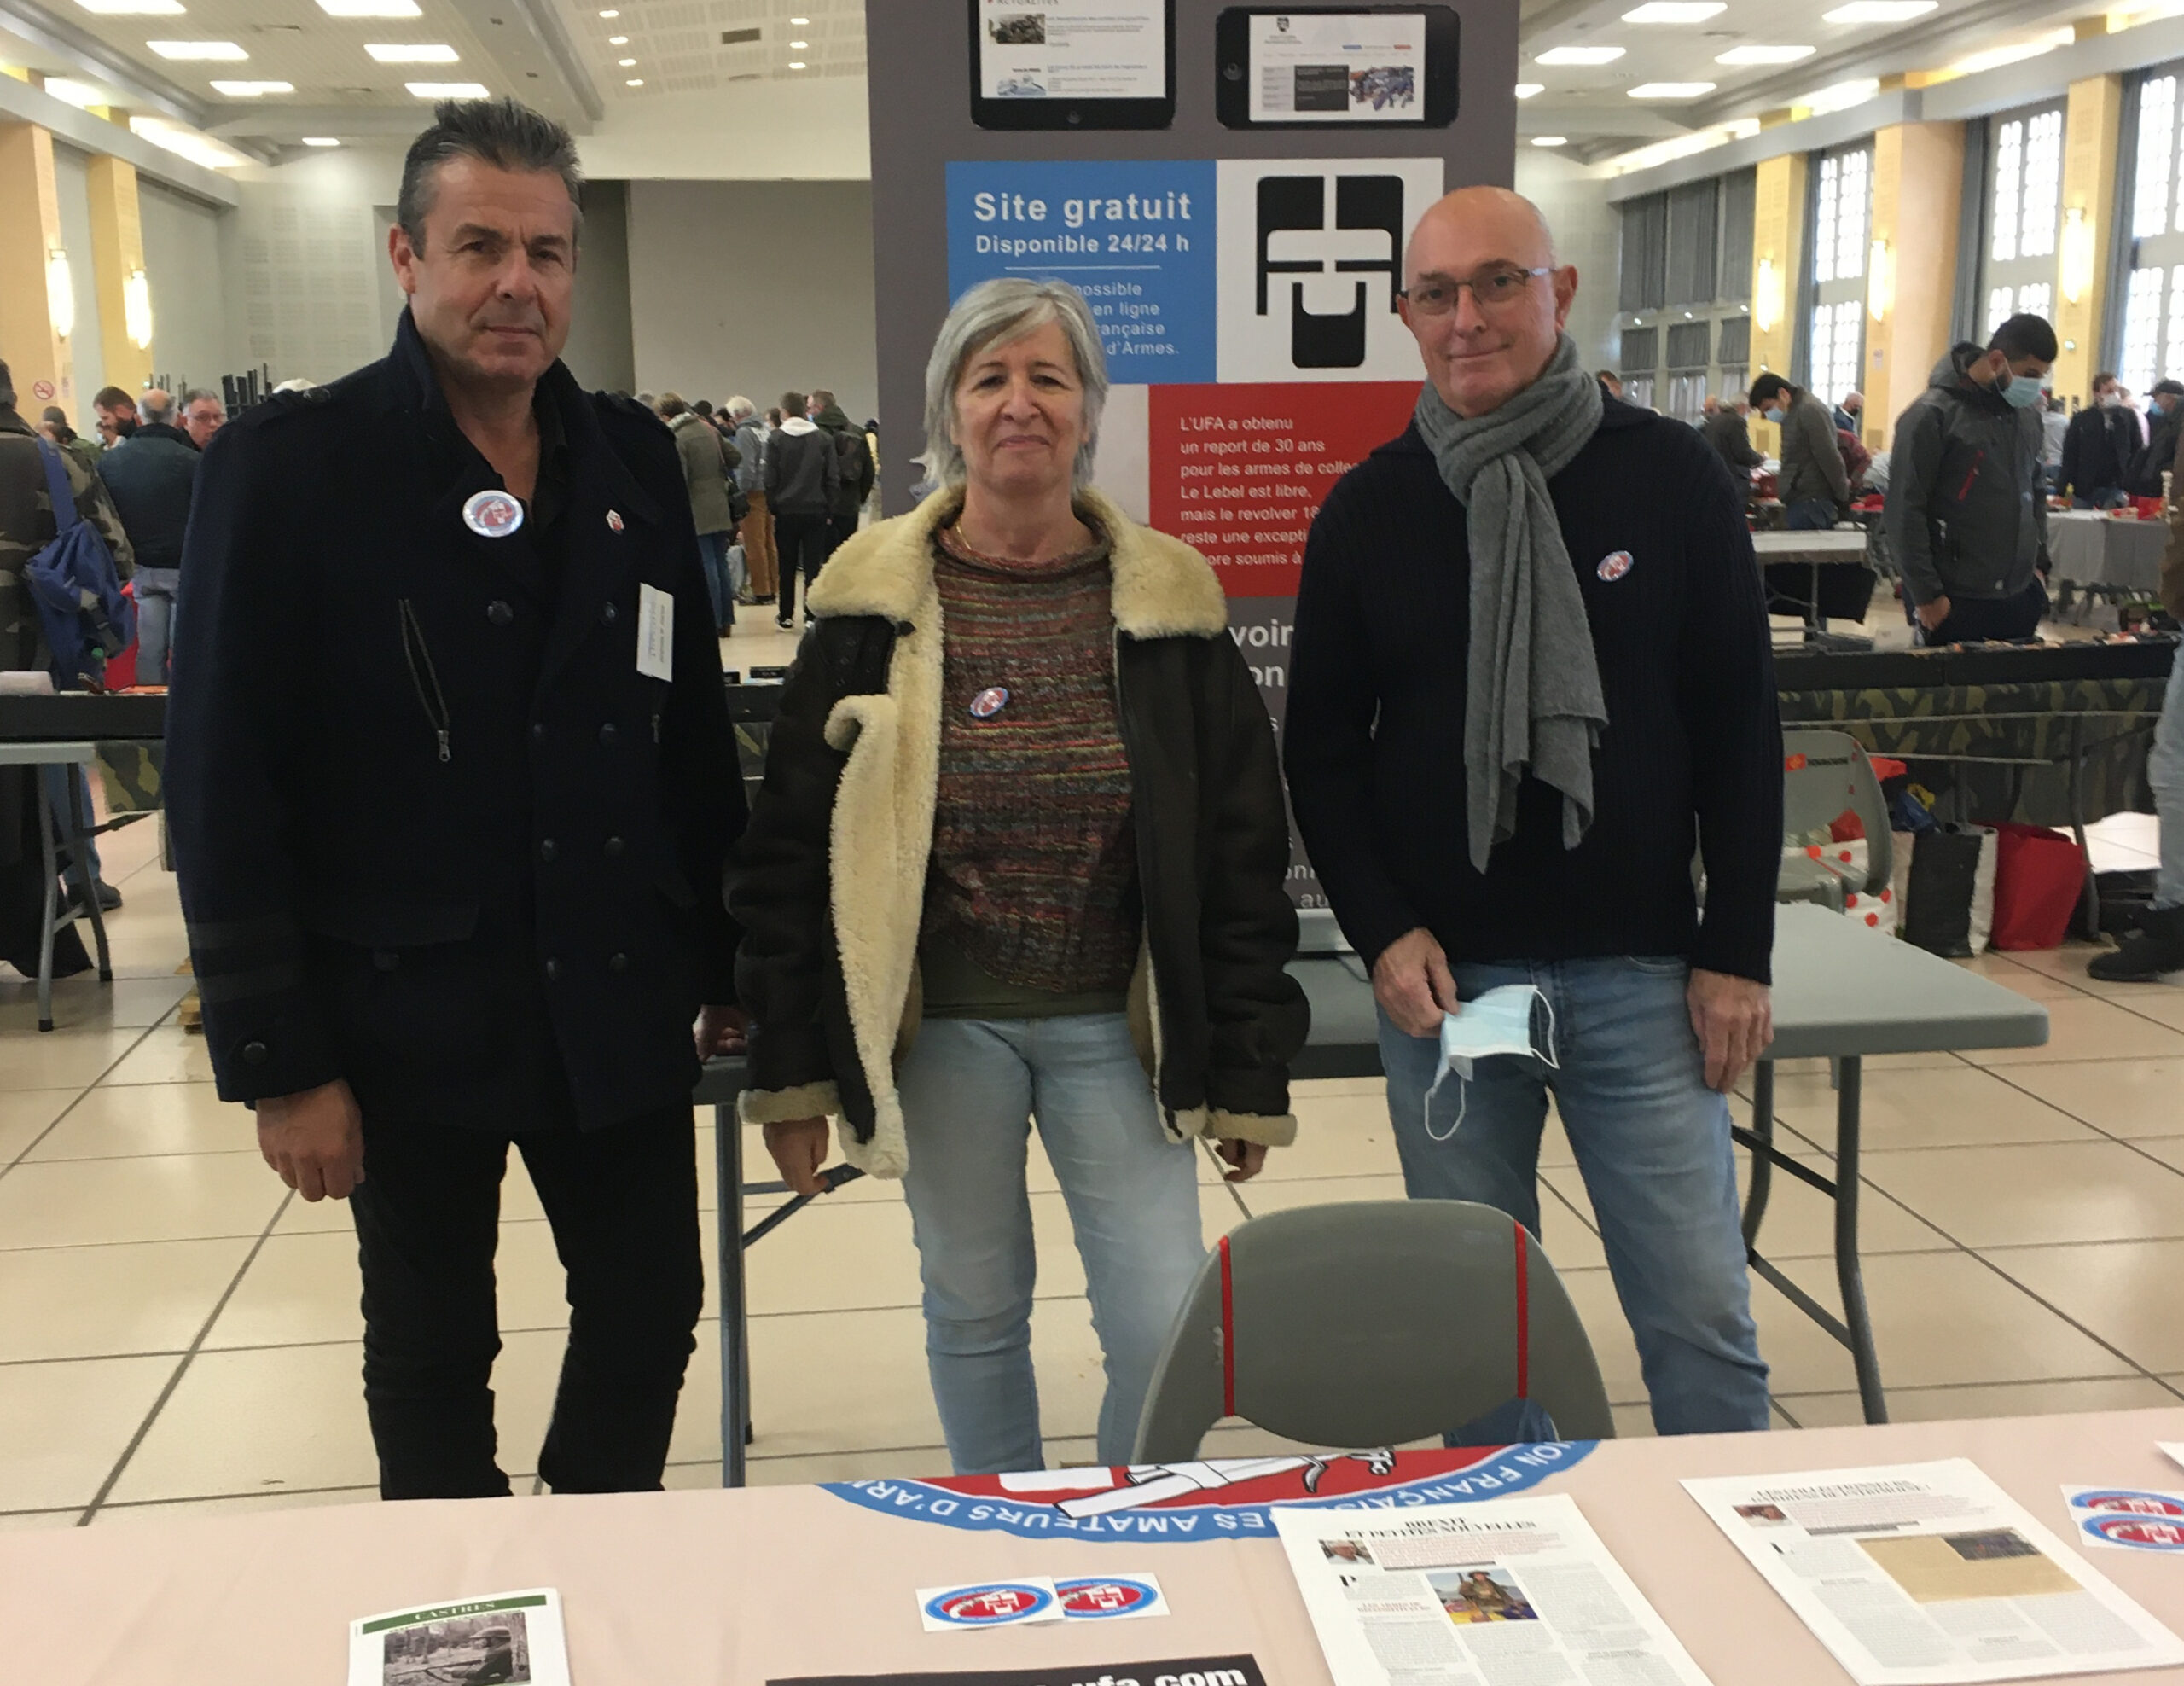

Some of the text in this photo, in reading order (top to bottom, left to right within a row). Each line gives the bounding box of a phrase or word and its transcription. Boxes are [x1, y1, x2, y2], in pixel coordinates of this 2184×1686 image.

[974, 191, 1192, 228] Site gratuit
[976, 234, 1189, 256] Disponible 24/24 h
[1093, 301, 1160, 319] en ligne
[1097, 321, 1165, 338] ançaise
[1107, 340, 1180, 356] d'Armes.
[1180, 416, 1294, 432] L'UFA a obtenu
[1180, 438, 1325, 456] un report de 30 ans
[1180, 465, 1215, 479] pour
[1217, 462, 1240, 475] les
[1244, 463, 1291, 476] armes
[1294, 461, 1314, 474] de
[1180, 485, 1199, 499] Le
[1204, 484, 1245, 499] Lebel
[1248, 485, 1272, 498] est
[1180, 508, 1216, 521] mais
[1220, 507, 1234, 520] le
[1238, 507, 1297, 520] revolver
[1180, 531, 1217, 544] reste
[1222, 532, 1251, 544] une
[1235, 550, 1288, 566] soumis
[1292, 551, 1302, 564] à
[967, 1504, 1199, 1533] AMATEURS
[1213, 1511, 1268, 1530] ES
[415, 1602, 496, 1621] CASTRES
